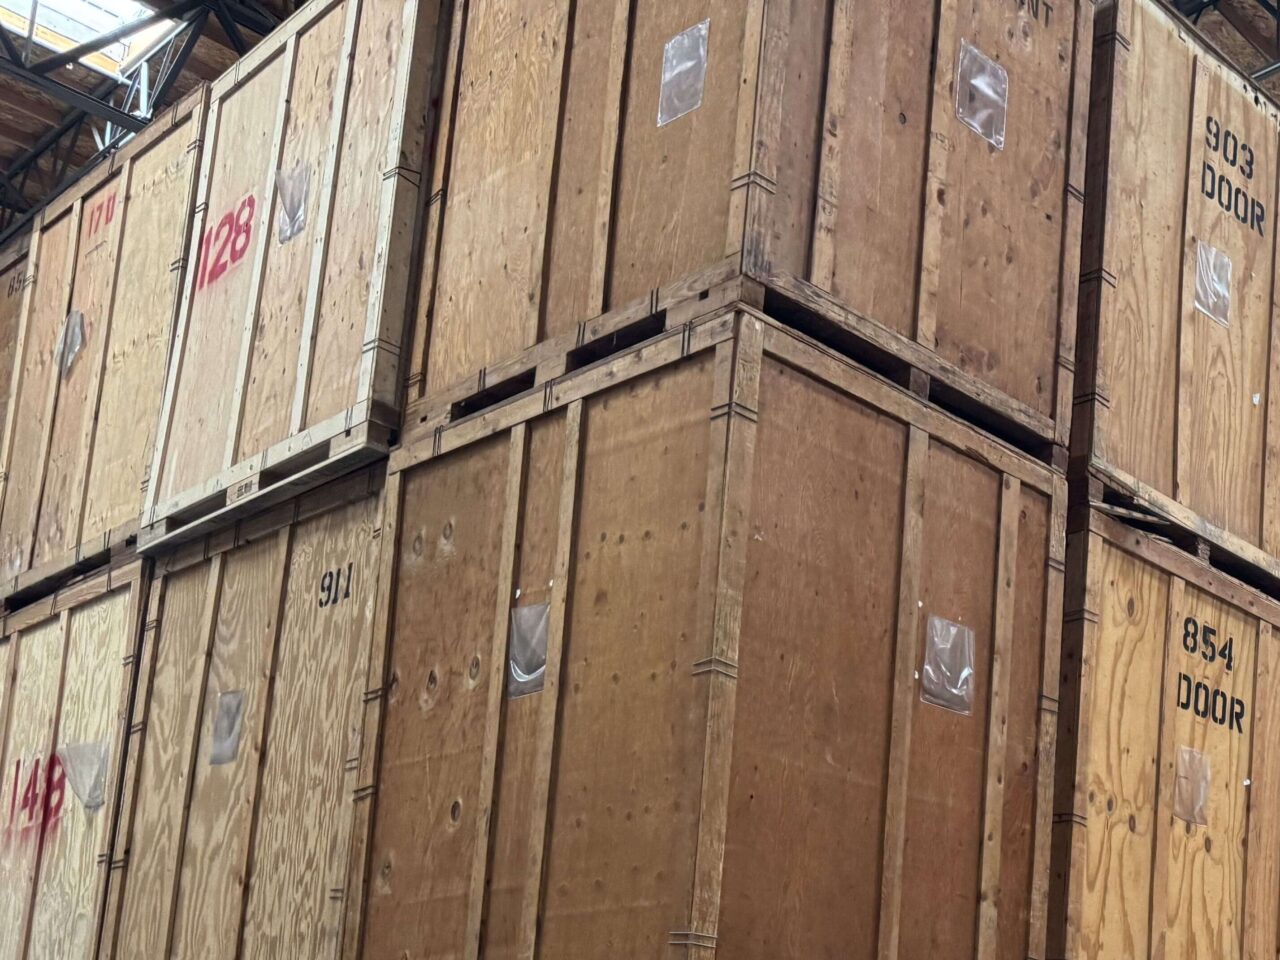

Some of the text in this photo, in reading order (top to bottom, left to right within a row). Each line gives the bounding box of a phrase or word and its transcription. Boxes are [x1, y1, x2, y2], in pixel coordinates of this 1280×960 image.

[1205, 115, 1255, 180] 903
[1201, 161, 1266, 237] DOOR
[199, 194, 256, 291] 128
[319, 562, 353, 608] 911
[1182, 616, 1233, 671] 854
[1177, 671, 1243, 734] DOOR
[10, 754, 66, 824] 148
